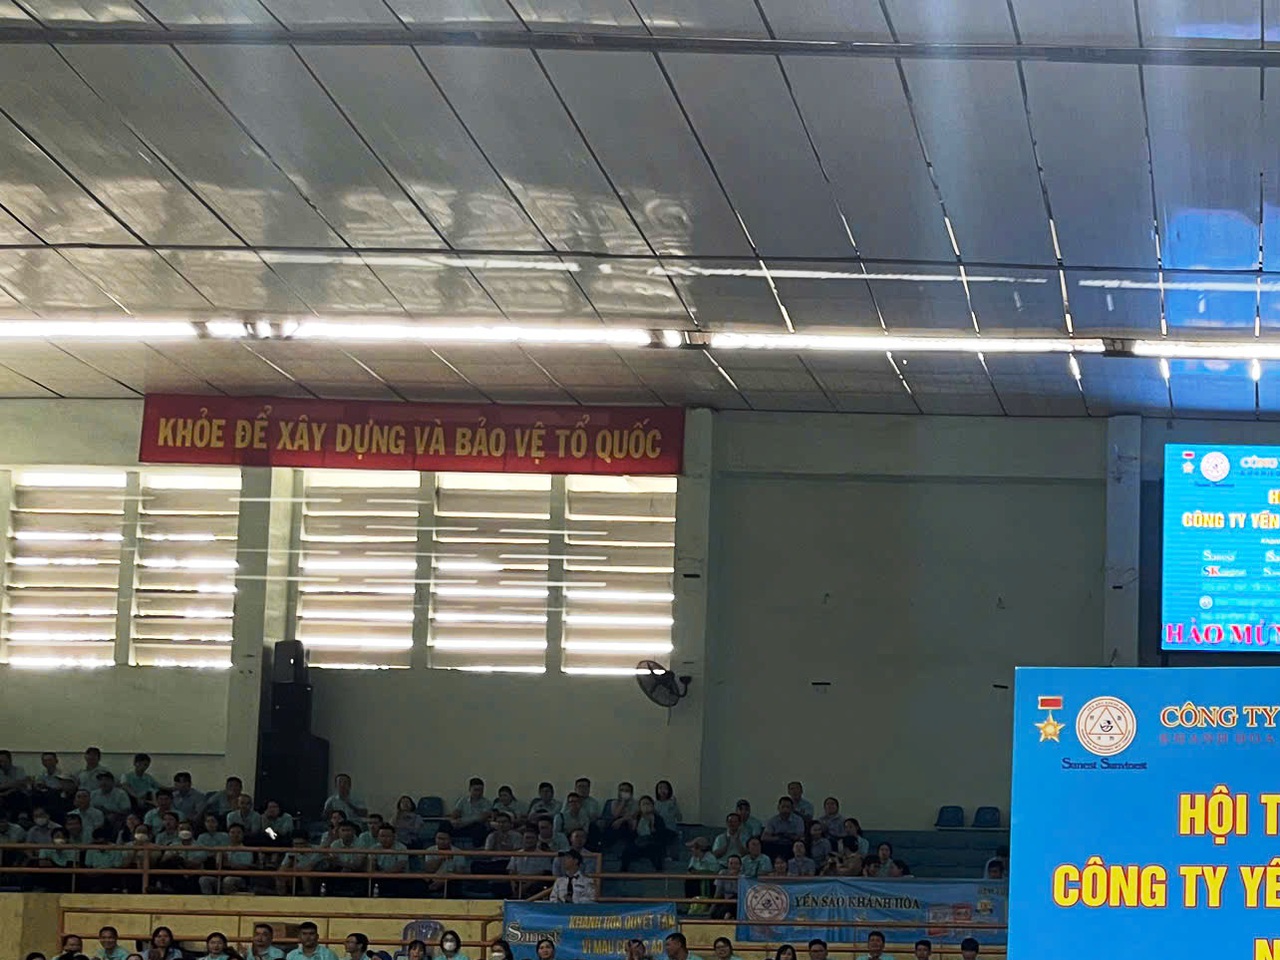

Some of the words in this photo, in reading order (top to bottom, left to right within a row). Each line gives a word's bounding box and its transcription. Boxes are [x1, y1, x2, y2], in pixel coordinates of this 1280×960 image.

[157, 409, 226, 449] KHỎE
[234, 405, 273, 450] ĐỂ
[276, 415, 328, 452] XÂY
[335, 418, 405, 460] DỰNG
[414, 418, 446, 456] VÀ
[454, 416, 502, 458] BẢO
[514, 422, 547, 464] VỆ
[555, 413, 591, 458] TỔ
[595, 418, 663, 464] QUỐC
[1182, 510, 1225, 528] CÔNG
[1229, 512, 1247, 529] TY
[1251, 509, 1280, 530] YẾN
[1159, 700, 1240, 728] CÔNG
[1242, 705, 1280, 728] TY
[1177, 784, 1249, 846] HỘI
[1052, 856, 1168, 908] CÔNG
[1178, 864, 1228, 909] TY
